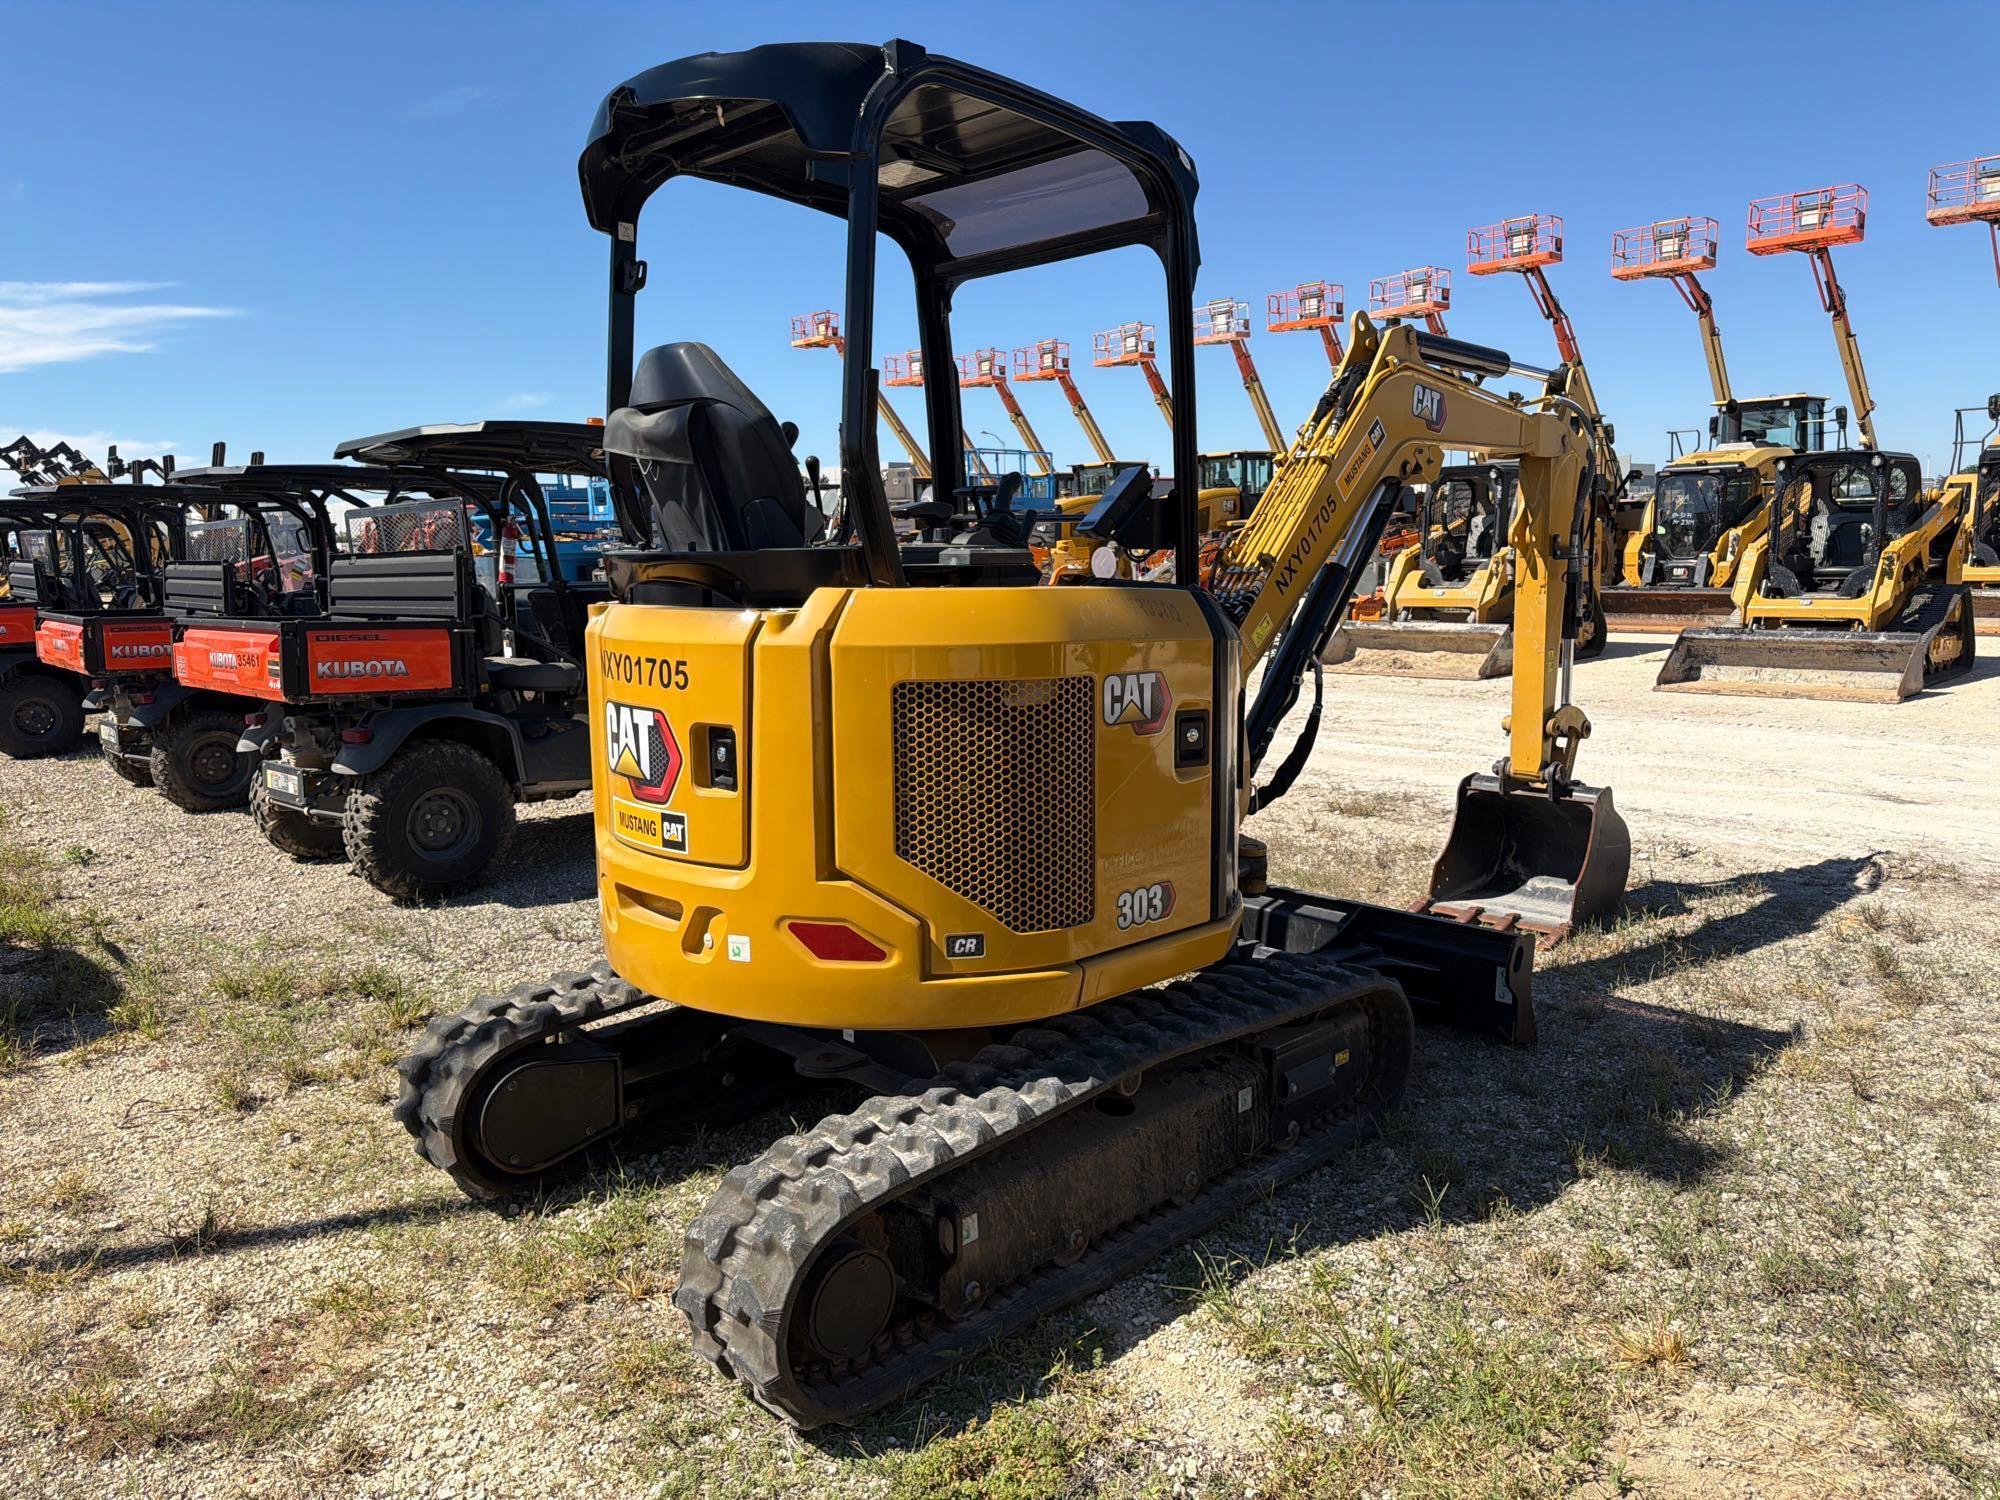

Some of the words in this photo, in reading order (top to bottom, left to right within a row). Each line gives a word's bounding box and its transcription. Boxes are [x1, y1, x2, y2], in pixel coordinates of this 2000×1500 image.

[1412, 384, 1441, 422] CAT
[1344, 444, 1372, 487] MUSTANG
[1370, 424, 1383, 446] CAT
[1275, 494, 1337, 596] NXY01705
[1673, 567, 1685, 576] CAT
[111, 645, 173, 659] KUBOT
[315, 634, 388, 642] DIESEL
[209, 651, 238, 670] KUBOTA
[237, 652, 260, 668] 35461
[317, 660, 409, 678] KUBOTA
[601, 650, 689, 690] NXY01705
[1104, 673, 1156, 725] CAT
[606, 701, 654, 780] CAT
[619, 811, 657, 837] MUSTANG
[663, 821, 685, 842] CAT
[1117, 884, 1163, 928] 303
[954, 938, 977, 954] CR
